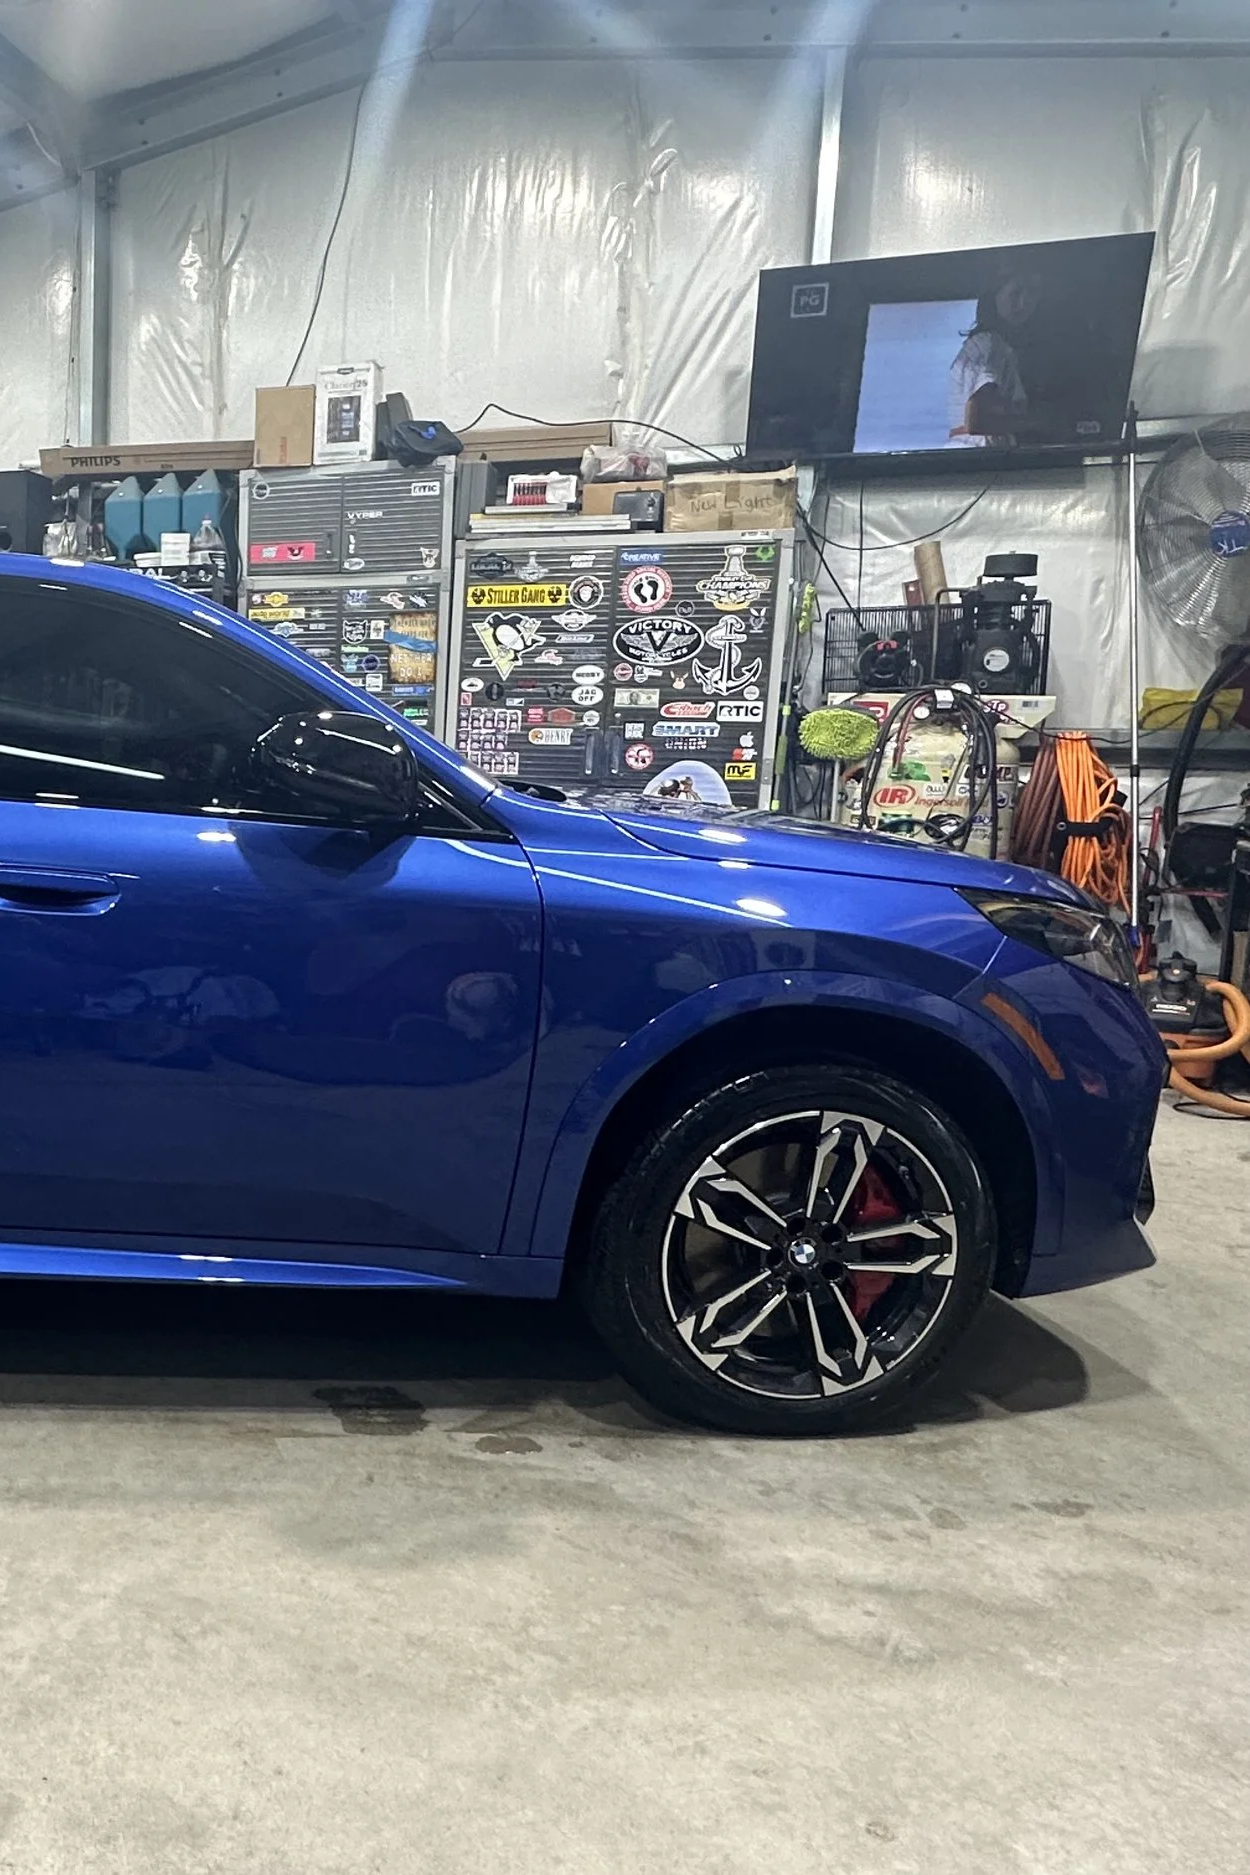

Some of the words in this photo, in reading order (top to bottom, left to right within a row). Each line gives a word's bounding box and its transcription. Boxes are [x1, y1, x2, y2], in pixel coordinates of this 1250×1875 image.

[70, 455, 121, 468] PHILIPS
[413, 484, 439, 495] RTIC
[724, 495, 776, 512] Light
[699, 580, 768, 590] CHAMPIONS
[487, 588, 520, 604] STILLER
[521, 587, 545, 603] GANG
[628, 619, 692, 634] VICTORY
[718, 705, 762, 717] RTIC
[544, 729, 571, 743] HENRY
[655, 725, 719, 736] SMART
[879, 787, 908, 805] IR
